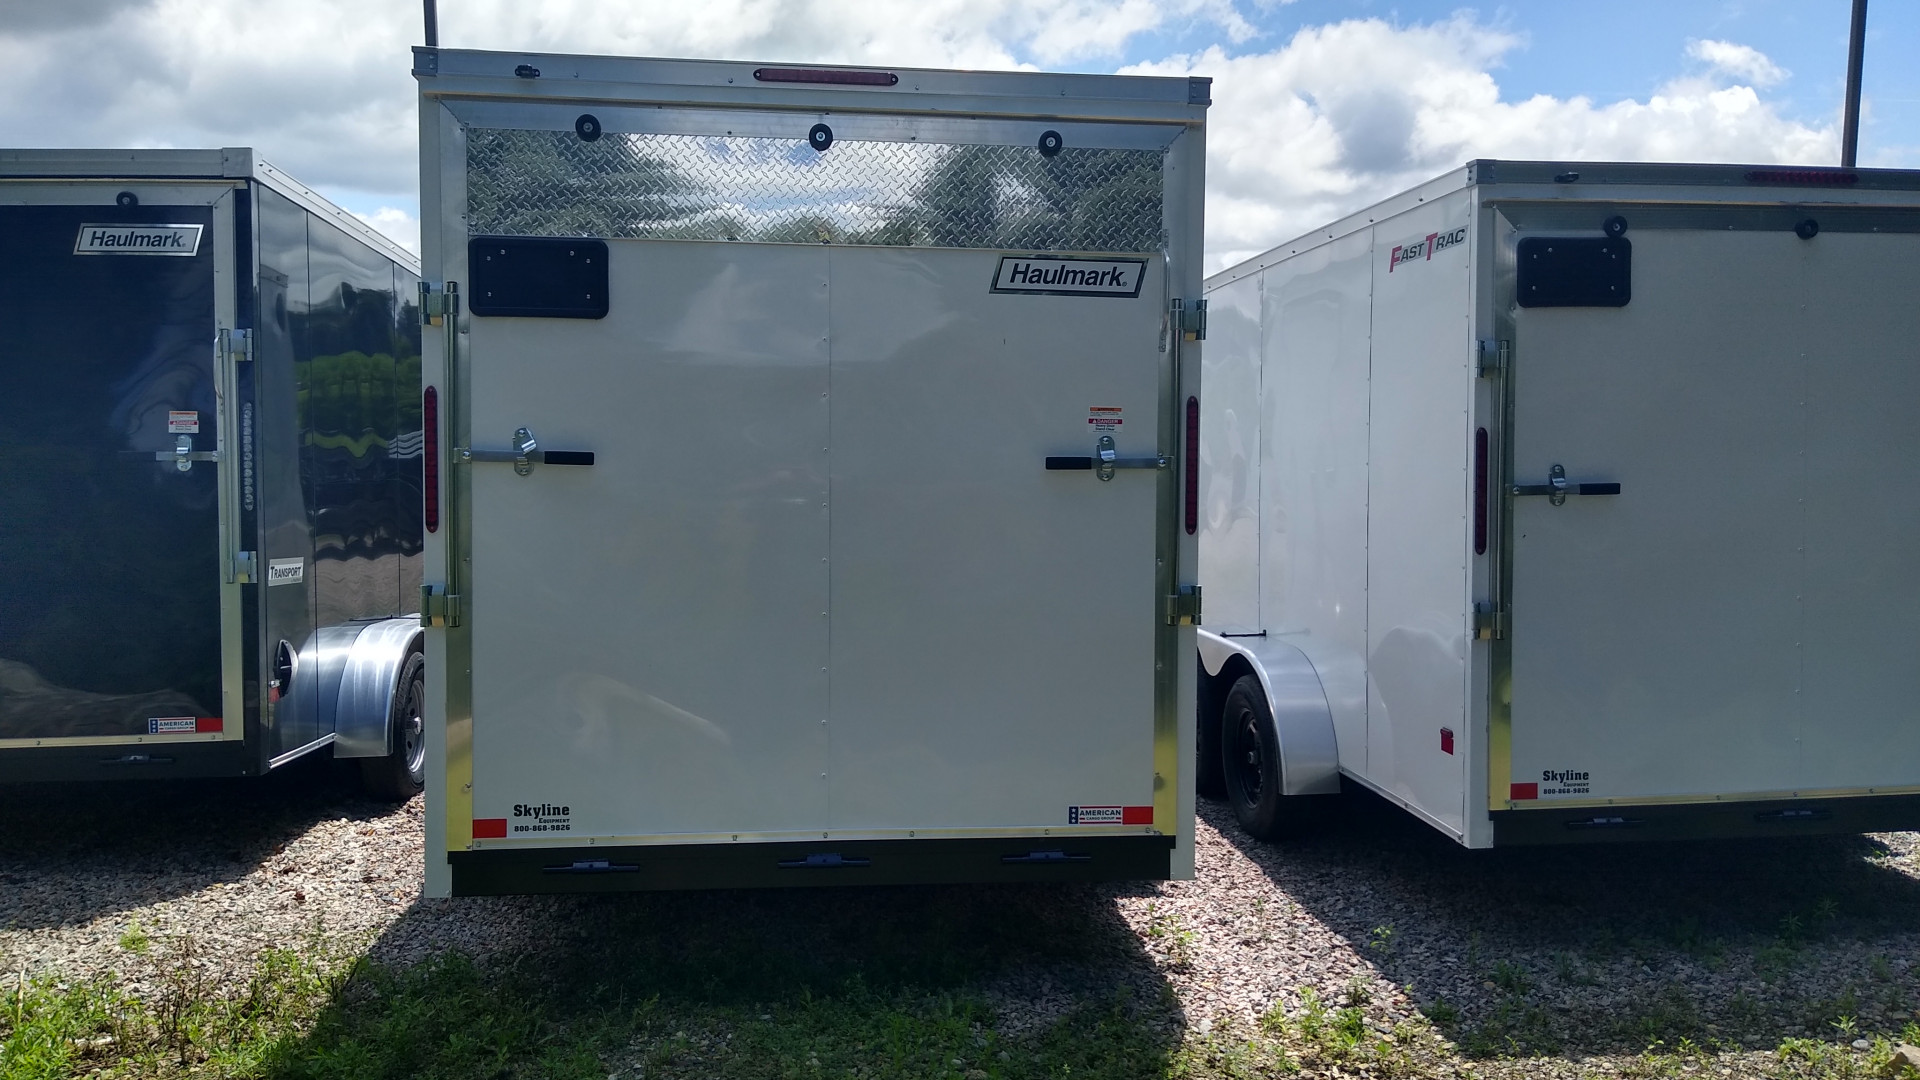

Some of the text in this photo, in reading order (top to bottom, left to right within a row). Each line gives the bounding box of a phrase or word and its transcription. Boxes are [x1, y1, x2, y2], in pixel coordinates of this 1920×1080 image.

[89, 230, 184, 248] Haulmark
[1009, 262, 1125, 287] Haulmark
[1542, 769, 1590, 784] Skyline
[513, 803, 570, 820] Skyline
[513, 824, 571, 832] 800-868-9826
